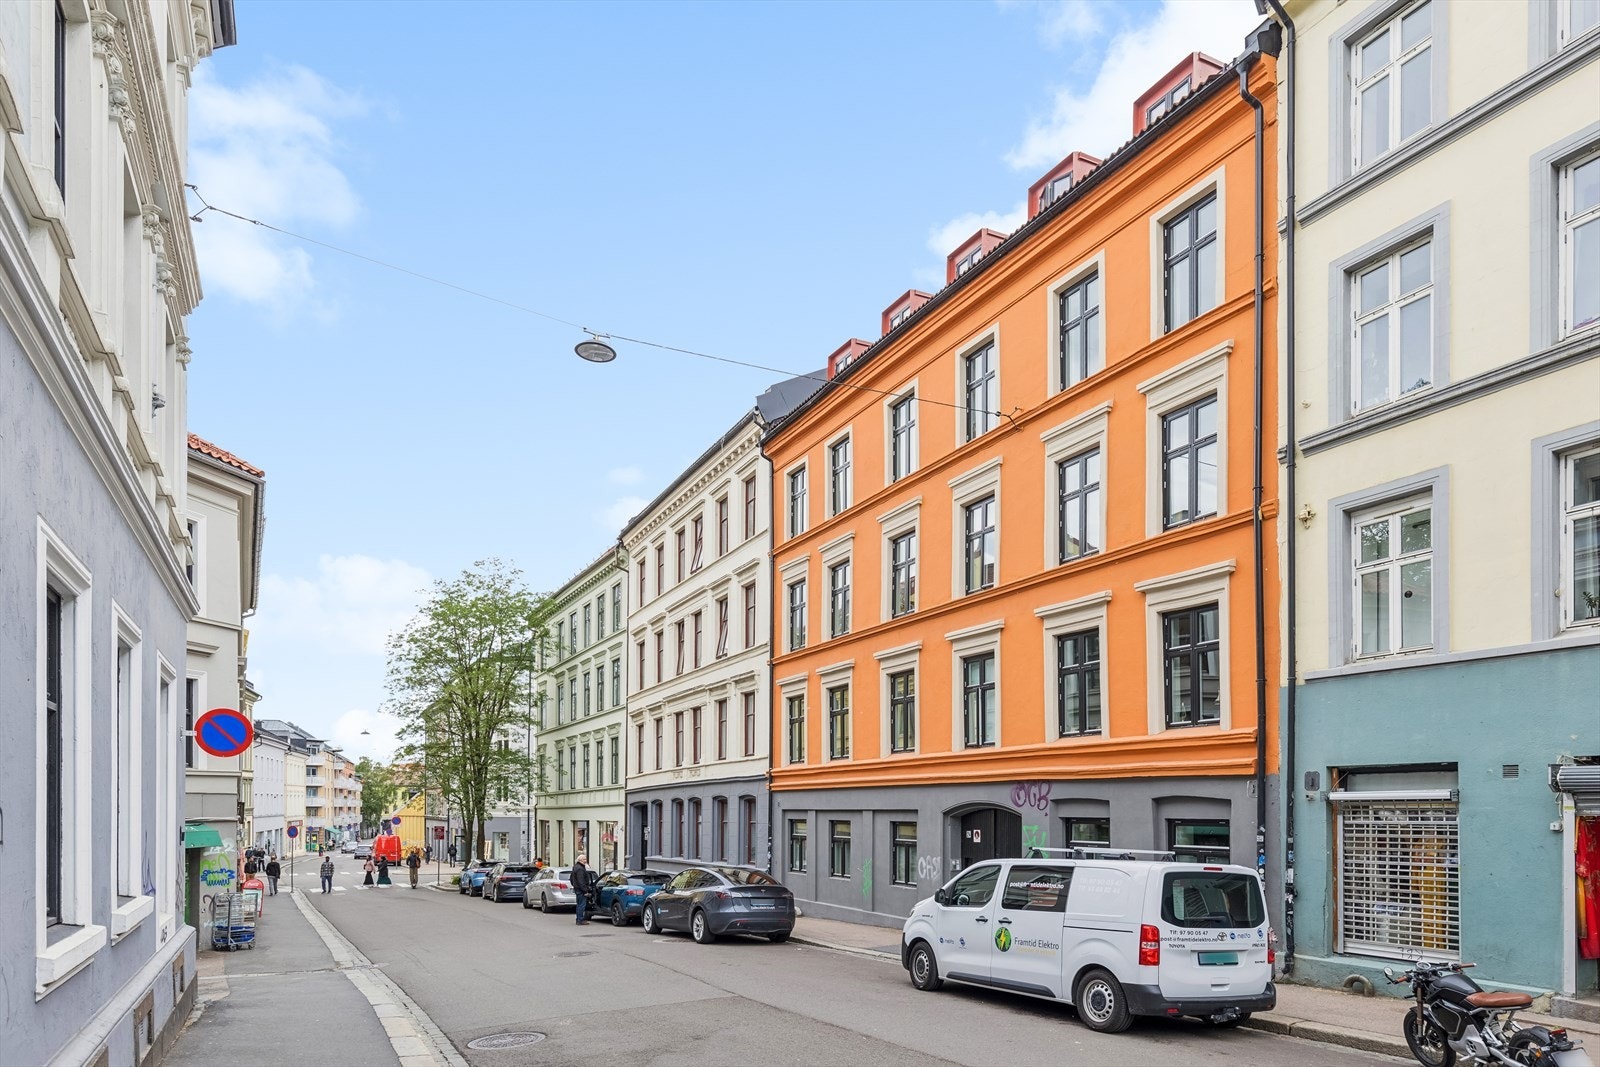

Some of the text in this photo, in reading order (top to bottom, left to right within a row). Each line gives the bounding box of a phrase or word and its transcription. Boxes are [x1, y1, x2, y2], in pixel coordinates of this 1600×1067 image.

[1009, 881, 1064, 889] post@frmtidelektro.no
[1014, 937, 1059, 950] Framtid Elektro
